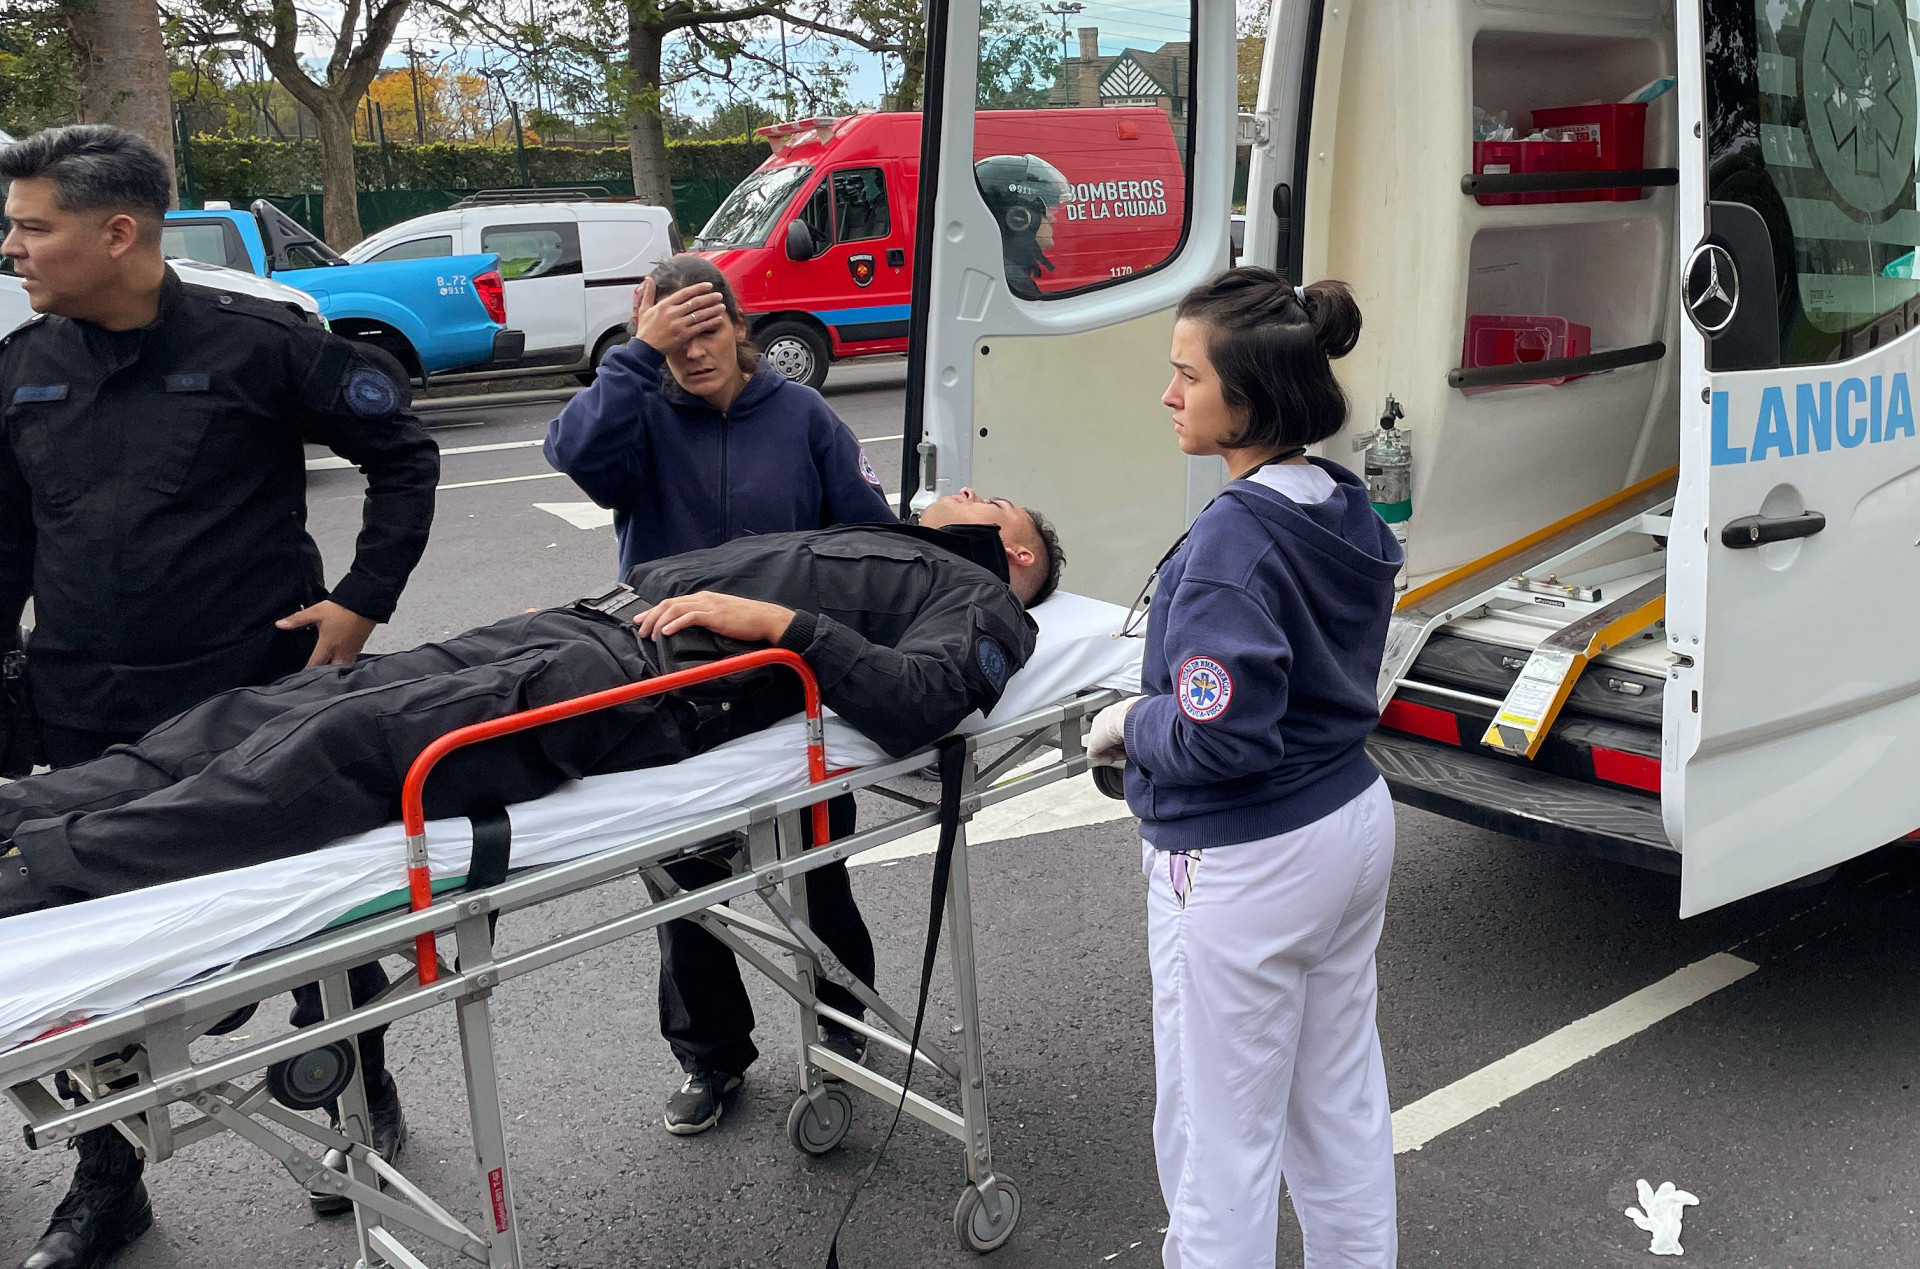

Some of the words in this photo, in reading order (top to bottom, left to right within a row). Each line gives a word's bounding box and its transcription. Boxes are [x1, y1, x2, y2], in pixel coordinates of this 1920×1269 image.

[1066, 203, 1088, 221] DE
[1090, 202, 1111, 219] LA
[1113, 199, 1167, 218] CIUDAD
[1109, 265, 1133, 278] 1170
[1711, 372, 1915, 466] LANCIA
